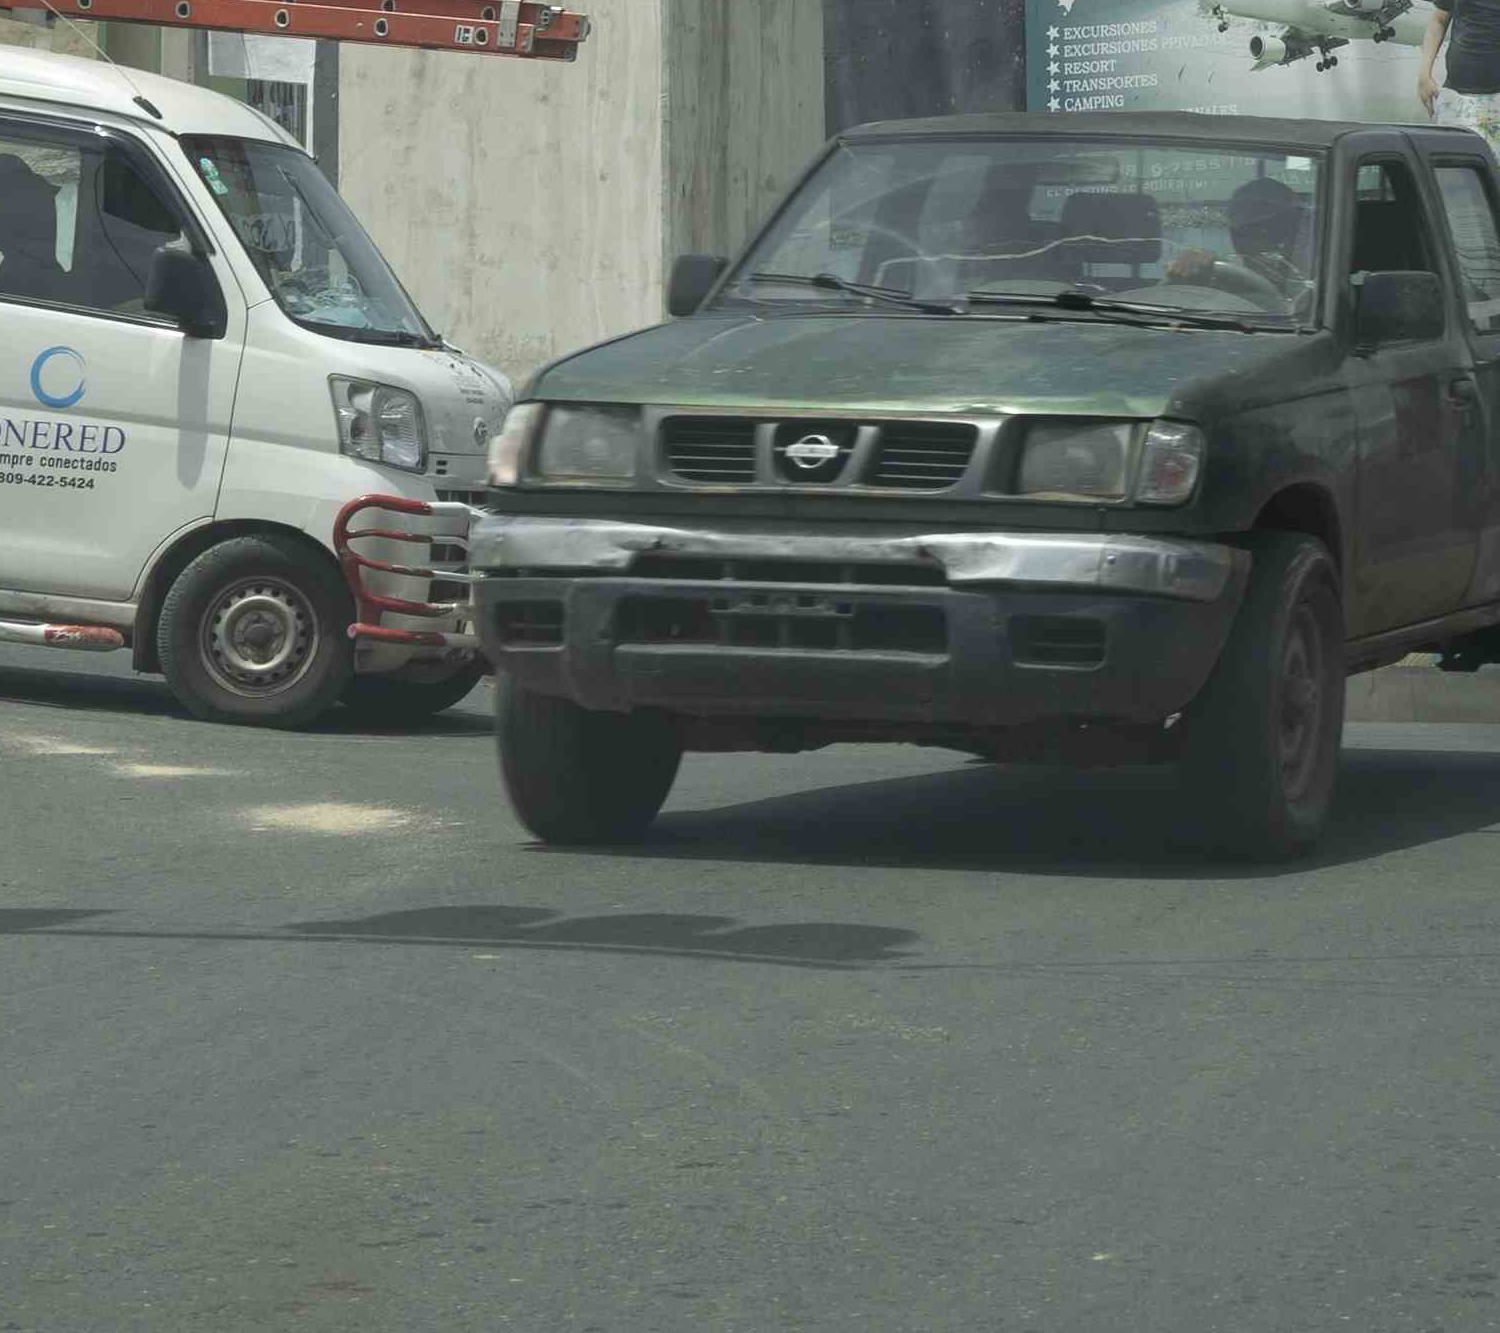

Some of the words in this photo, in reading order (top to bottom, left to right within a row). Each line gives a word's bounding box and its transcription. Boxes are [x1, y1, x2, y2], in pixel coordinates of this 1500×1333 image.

[1063, 22, 1157, 41] EXCURSIONES
[1063, 39, 1157, 58] EXCURSIONES
[1064, 59, 1117, 75] RESORT
[1064, 74, 1158, 93] TRANSPORTES
[1064, 95, 1124, 112] CAMPING
[39, 455, 118, 473] conectados
